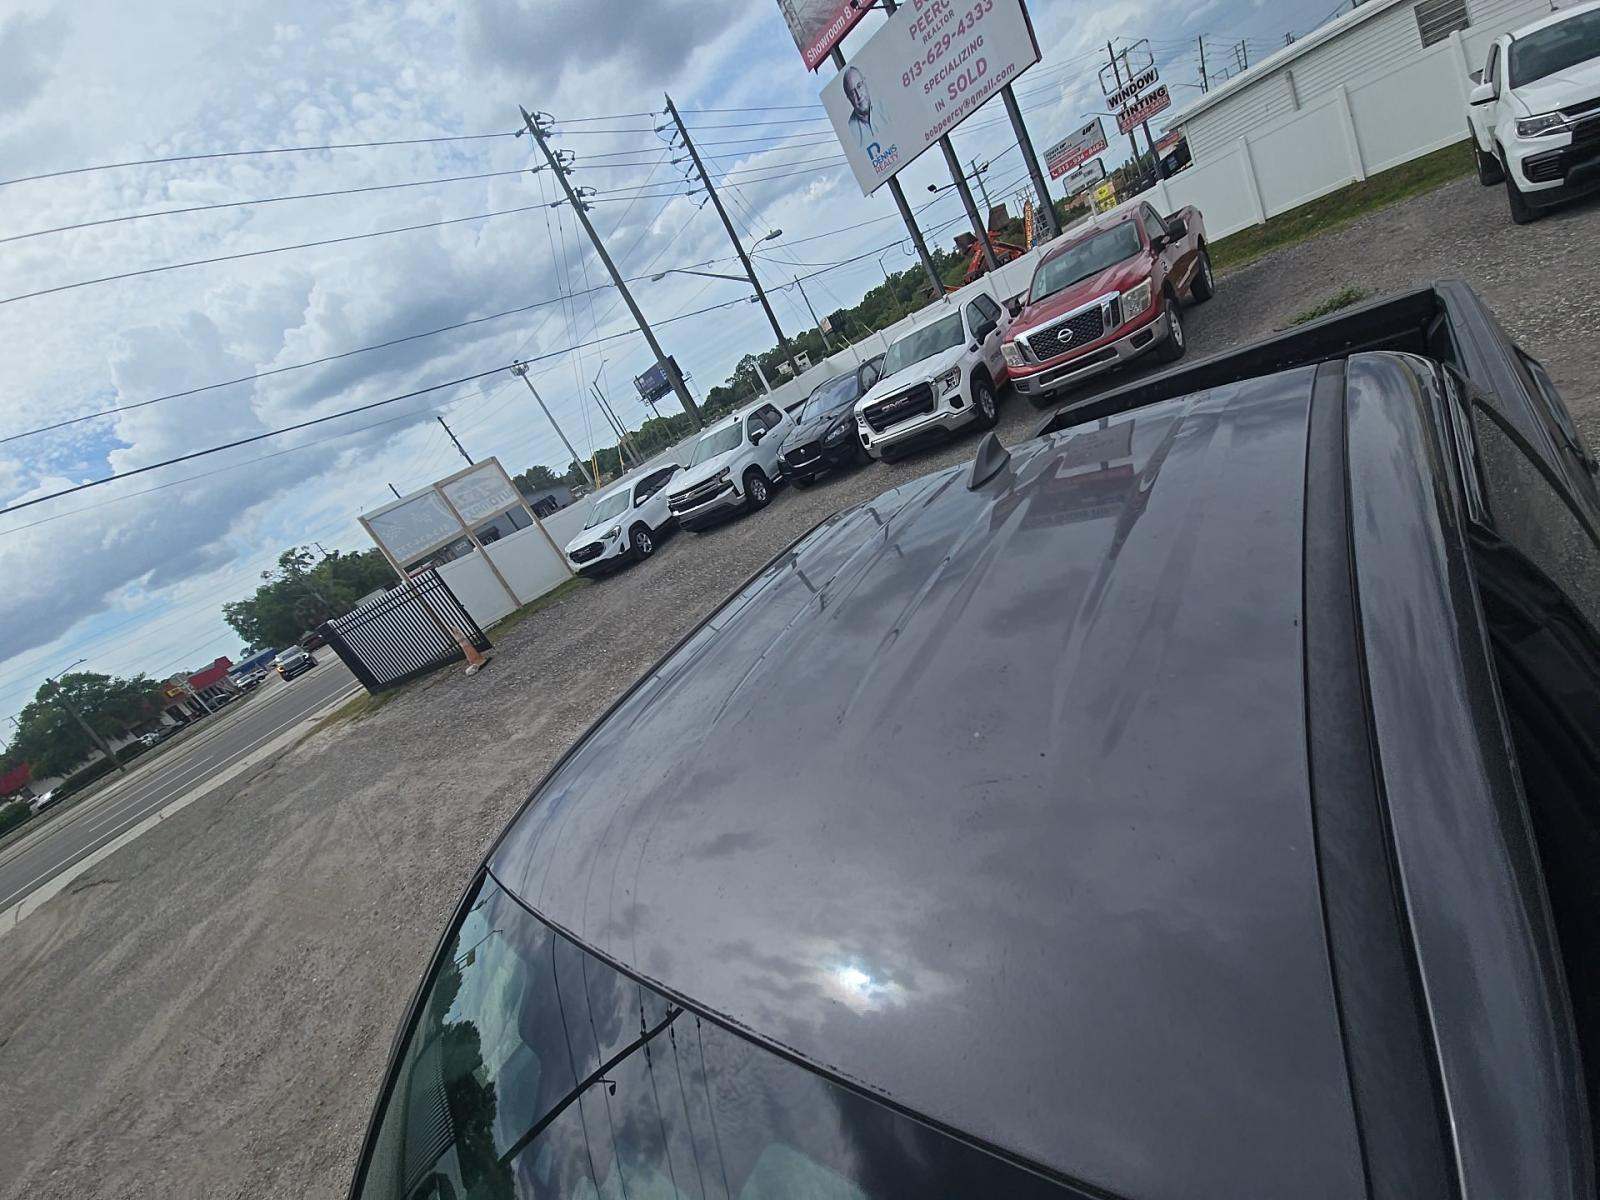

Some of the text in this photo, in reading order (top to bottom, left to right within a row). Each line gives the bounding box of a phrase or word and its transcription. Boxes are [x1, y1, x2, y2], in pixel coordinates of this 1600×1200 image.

[806, 16, 846, 62] Showroom
[902, 0, 993, 87] 813-629-4333
[922, 9, 955, 44] REALTOR
[924, 35, 984, 94] SPECIALIZING
[934, 57, 988, 112] IN SOLD
[924, 63, 1015, 141] bobpeercy@gmail.com
[1108, 70, 1154, 108] WINDOW
[1119, 88, 1166, 120] TINTING
[872, 144, 897, 168] DENNIS
[881, 397, 908, 412] GMC
